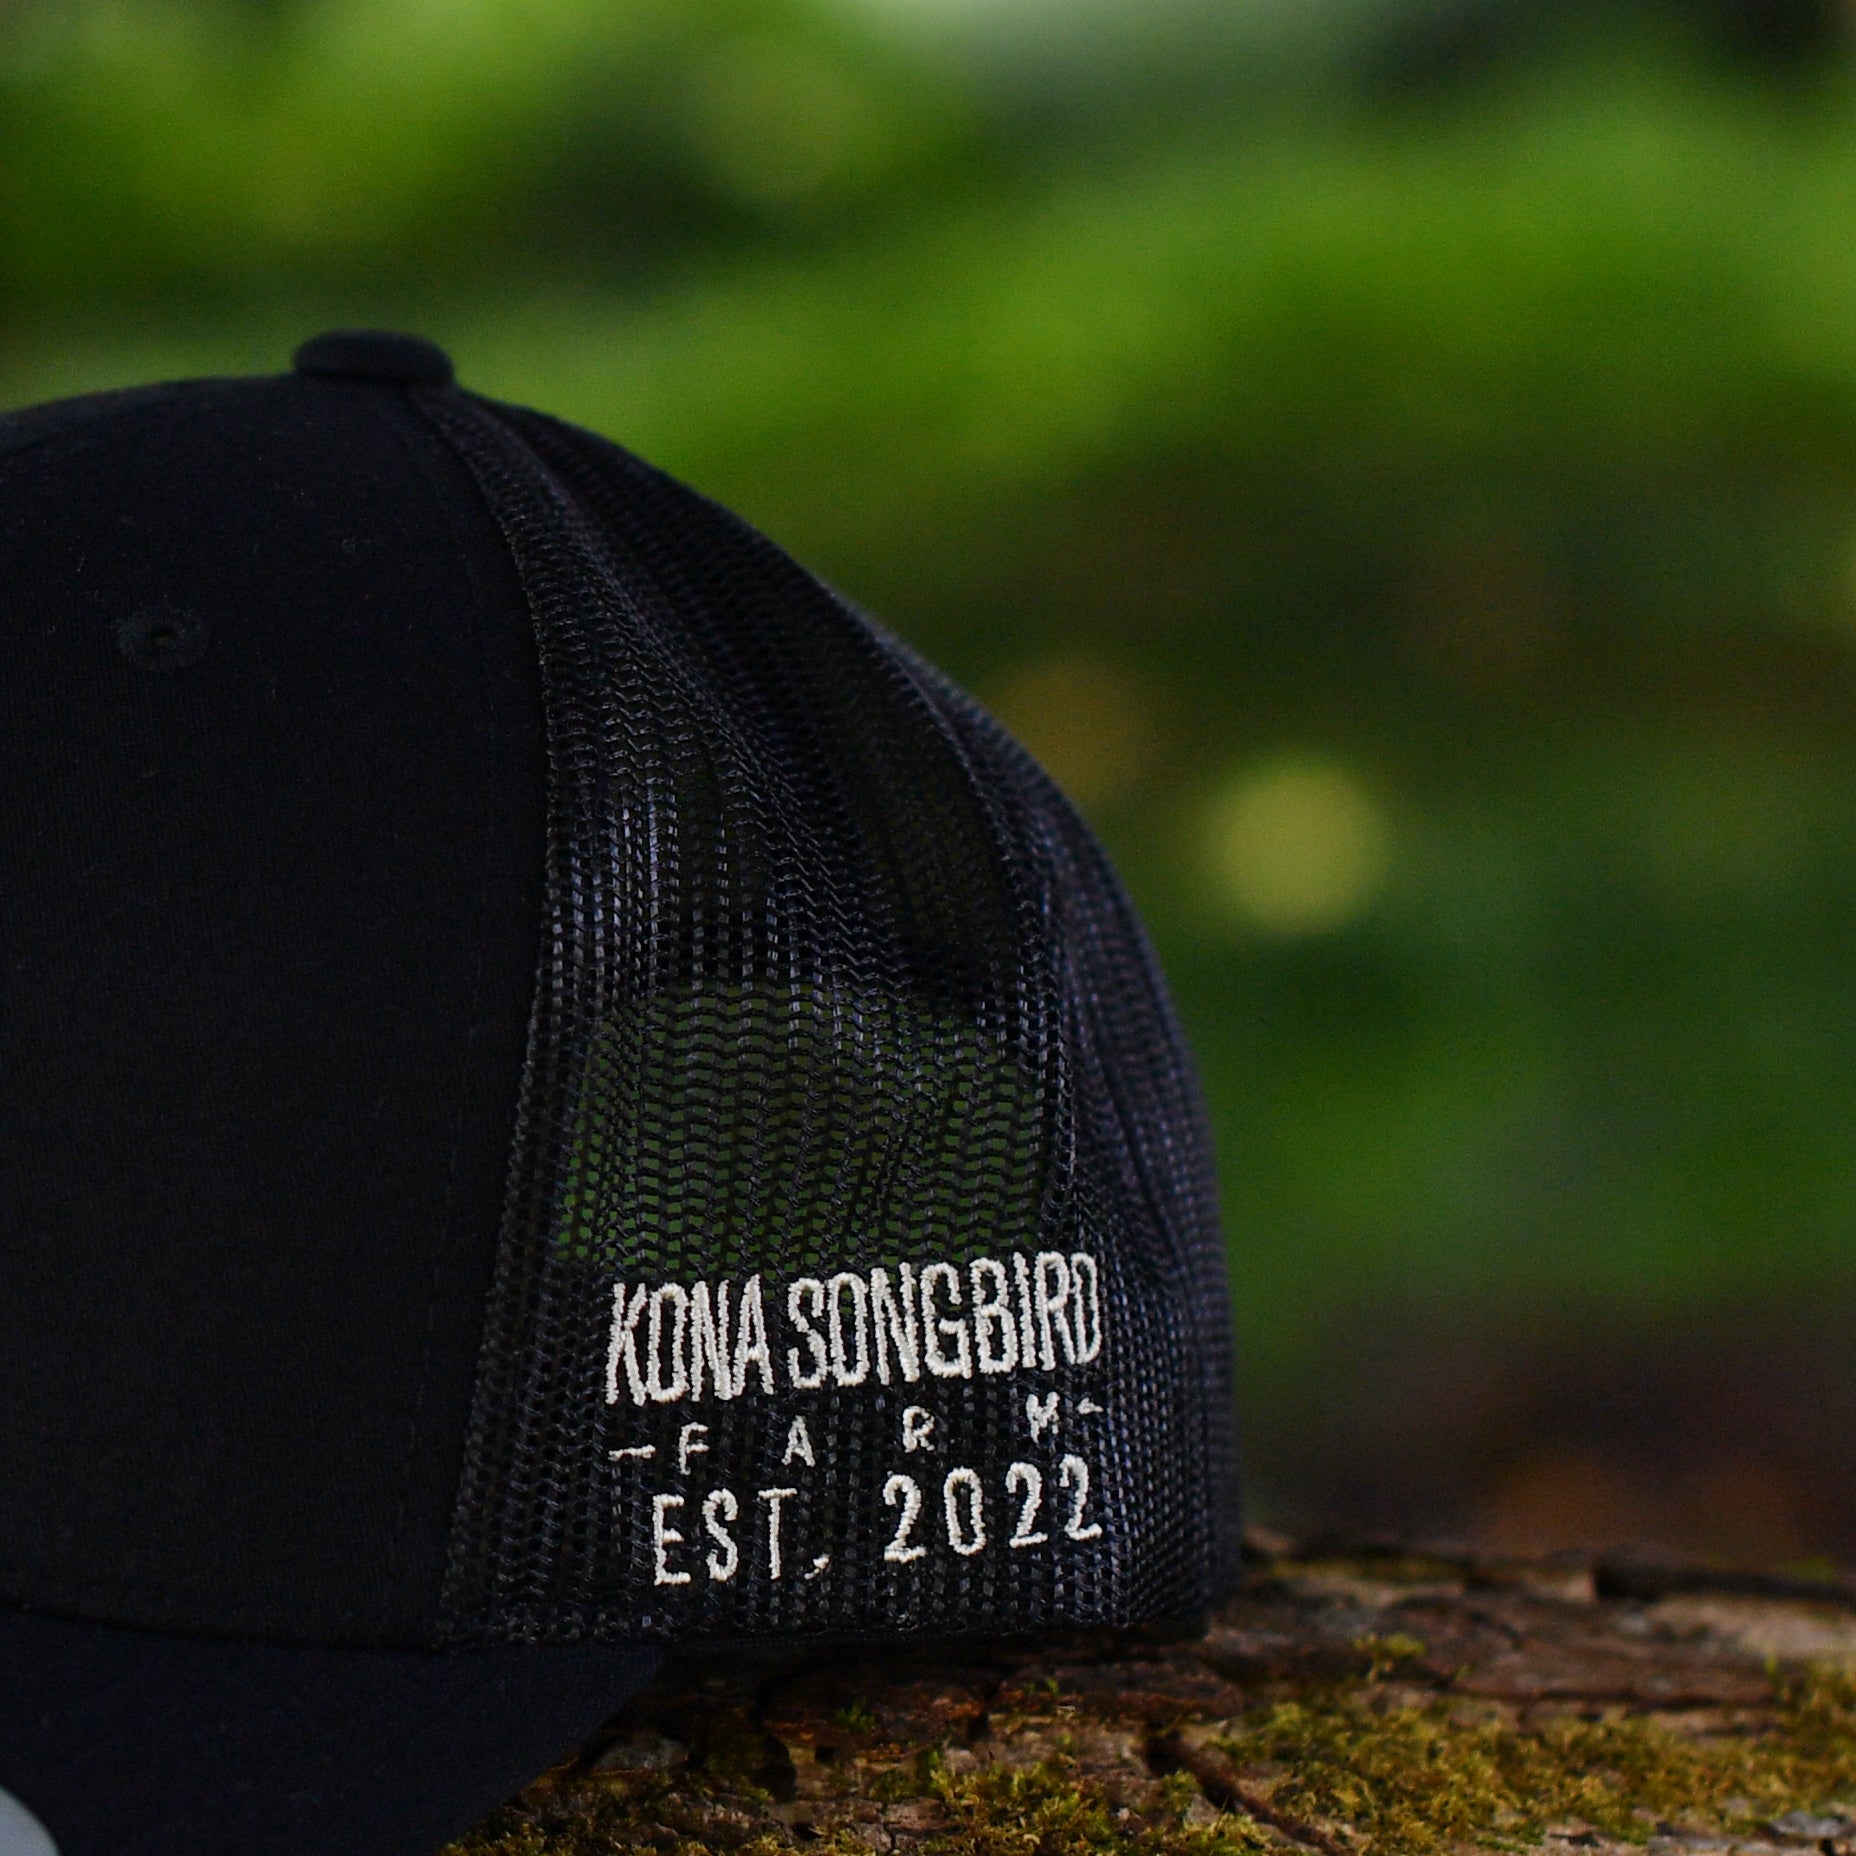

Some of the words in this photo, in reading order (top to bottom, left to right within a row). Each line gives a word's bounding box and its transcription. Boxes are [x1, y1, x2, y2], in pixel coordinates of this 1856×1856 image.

[605, 1274, 775, 1406] KONA
[787, 1250, 1103, 1390] SONGBIRD
[678, 1391, 1061, 1475] FARM
[882, 1454, 1104, 1563] 2022
